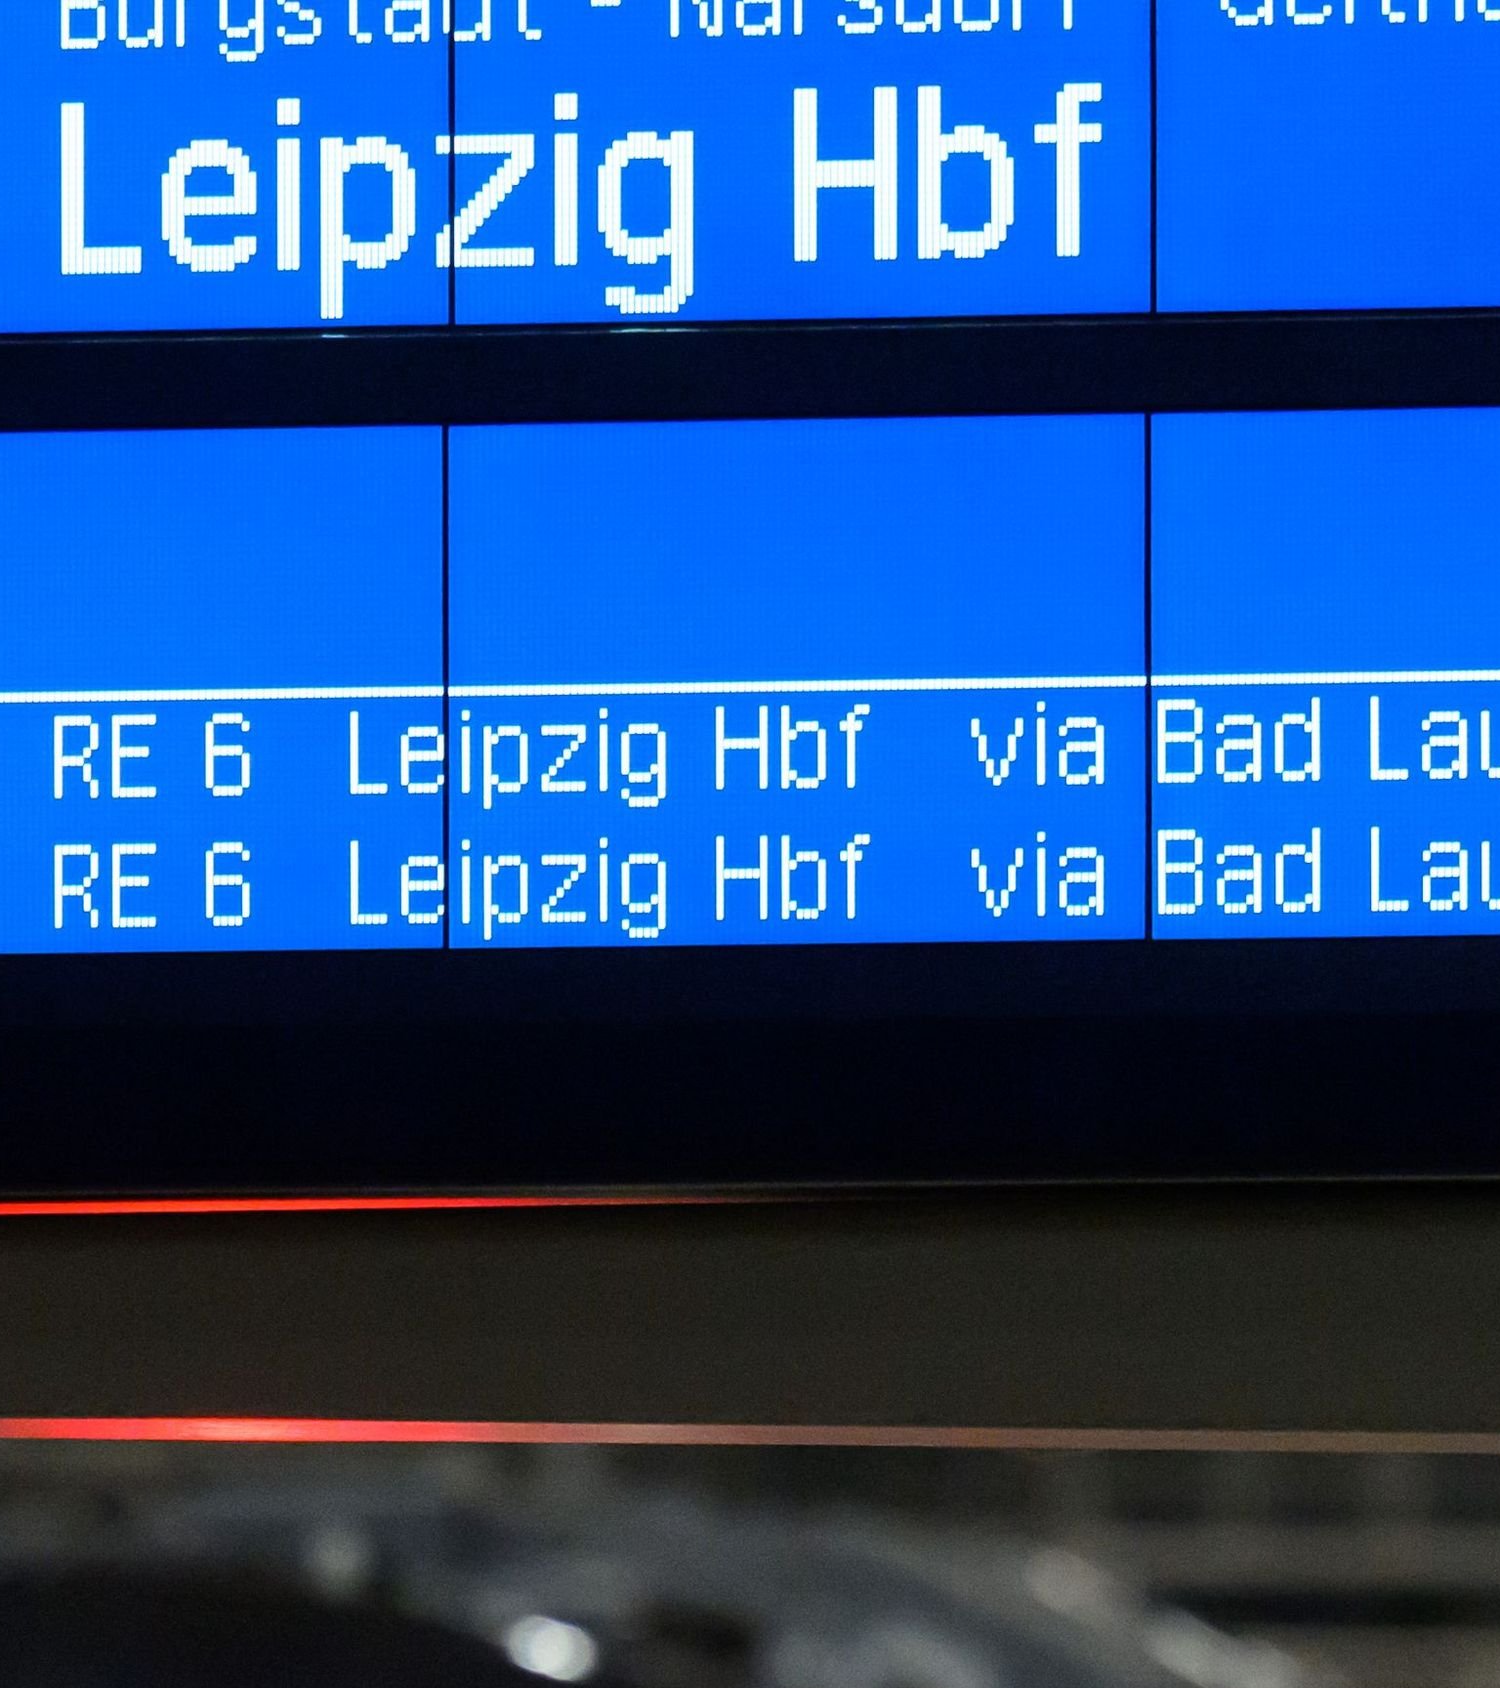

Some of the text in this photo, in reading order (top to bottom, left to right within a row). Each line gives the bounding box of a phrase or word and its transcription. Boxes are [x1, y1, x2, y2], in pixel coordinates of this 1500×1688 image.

[60, 93, 694, 320] Leipzig
[793, 83, 1102, 262] Hbf
[54, 714, 157, 798] RE
[205, 712, 251, 796] 6
[350, 708, 667, 809] Leipzig
[715, 704, 870, 791] Hbf
[970, 701, 1105, 786] via
[1157, 696, 1321, 784] Bad
[54, 843, 157, 928] RE
[205, 841, 251, 926] 6
[350, 838, 667, 941] Leipzig
[715, 833, 870, 921] Hbf
[971, 831, 1105, 917] via
[1157, 827, 1321, 915] Bad
